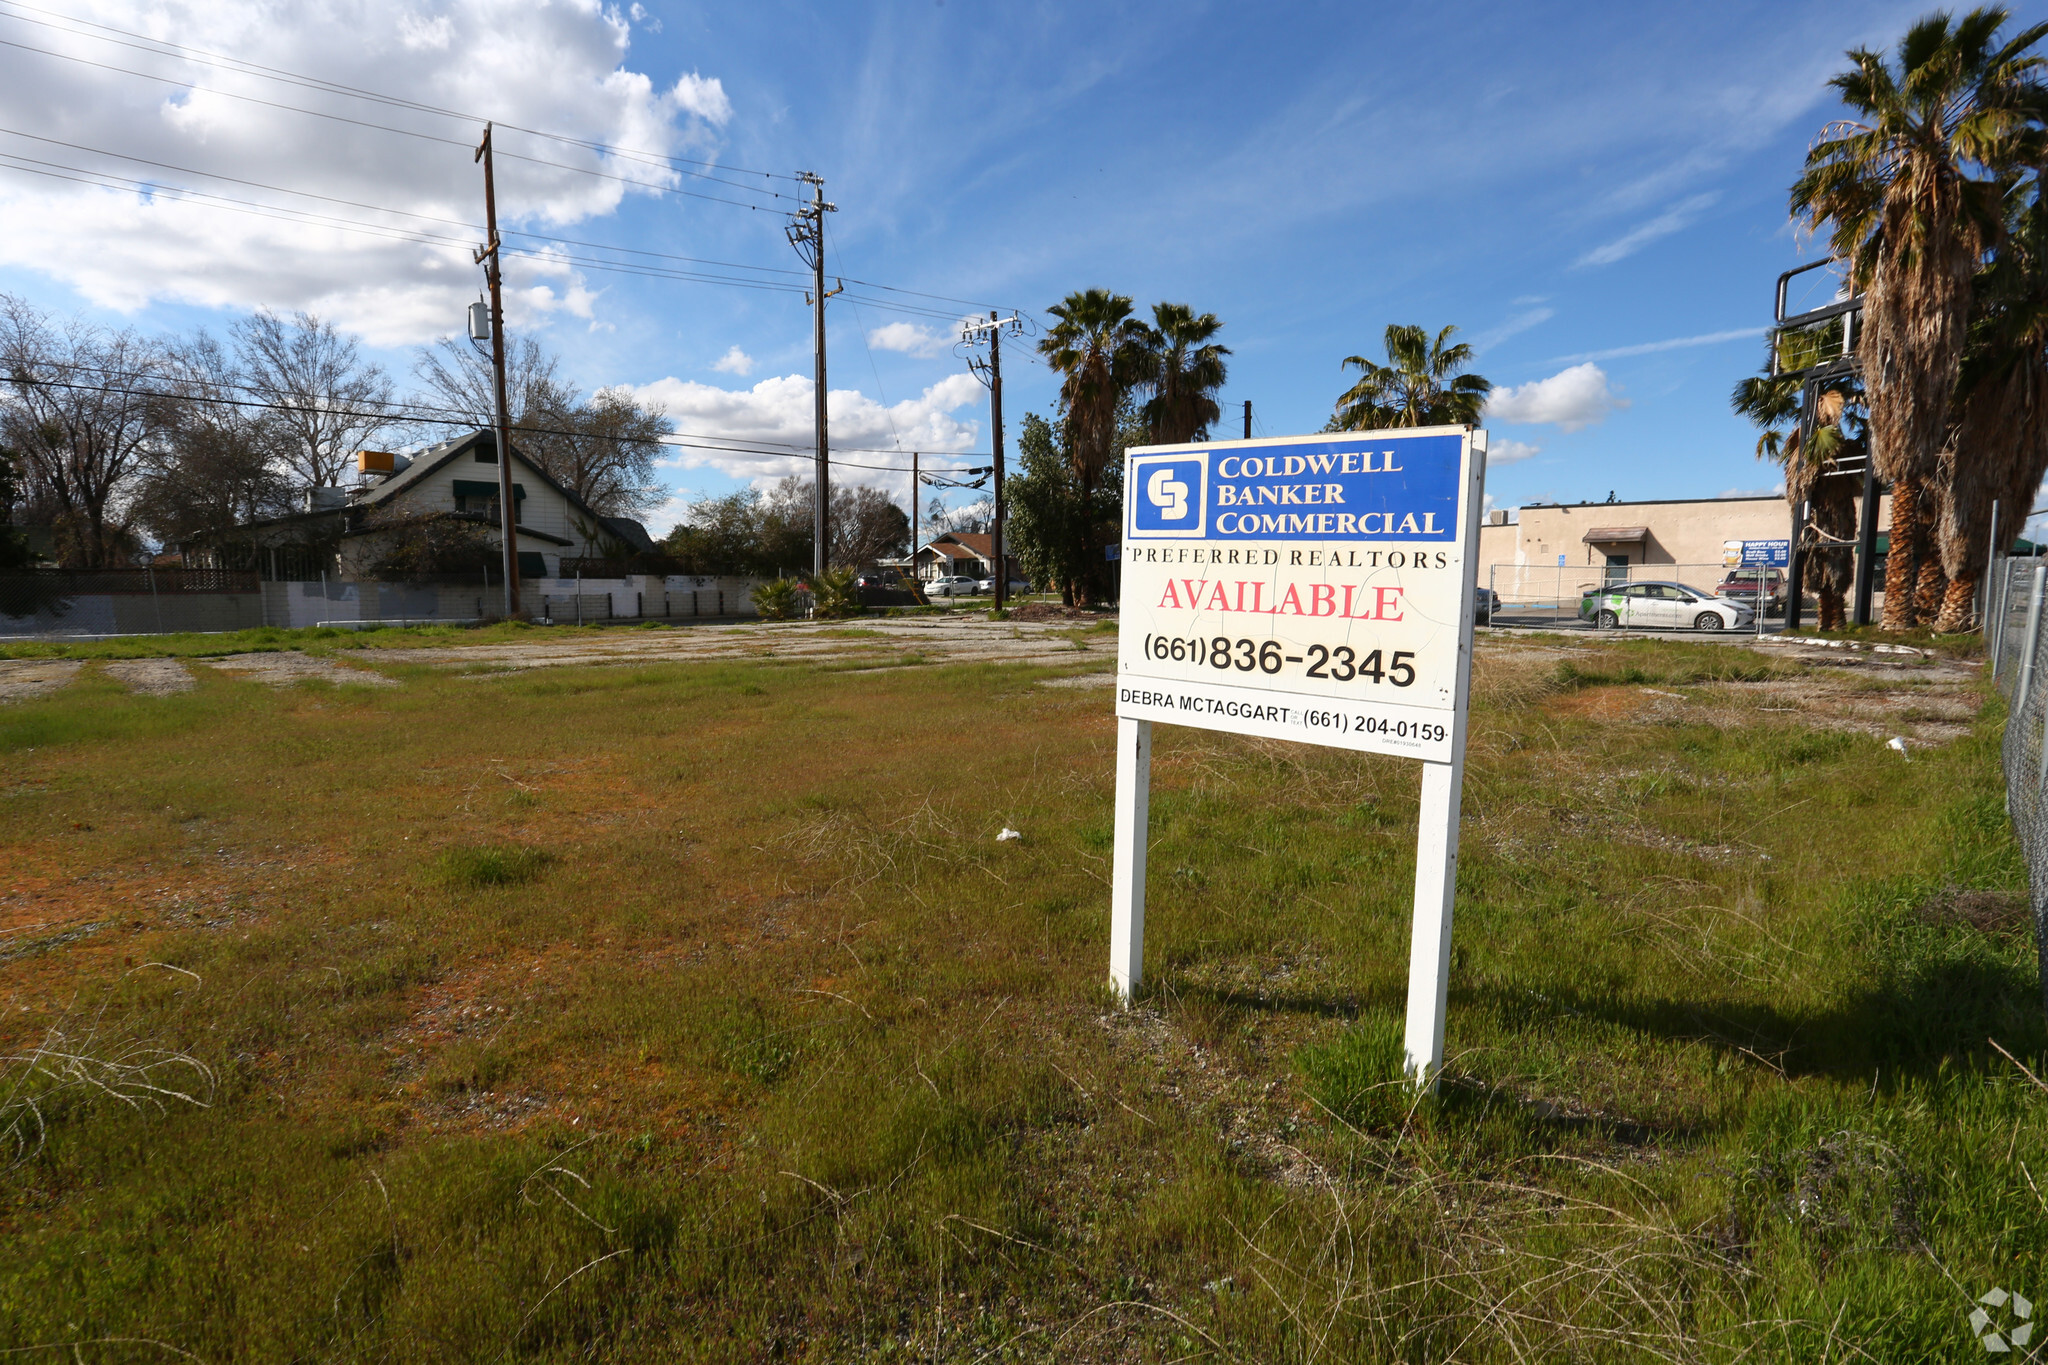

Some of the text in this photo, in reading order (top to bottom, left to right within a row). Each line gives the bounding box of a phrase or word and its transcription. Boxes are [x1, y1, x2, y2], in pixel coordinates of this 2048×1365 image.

[1218, 451, 1404, 479] COLDWELL
[1217, 483, 1346, 506] BANKER
[1216, 512, 1445, 534] COMMERCIAL
[1132, 547, 1448, 570] PREFERRED REALTORS
[1157, 578, 1405, 622] AVAILABLE
[1121, 689, 1291, 723] DEBRA MCTAGGART
[1303, 709, 1446, 742] (661) 204-0159
